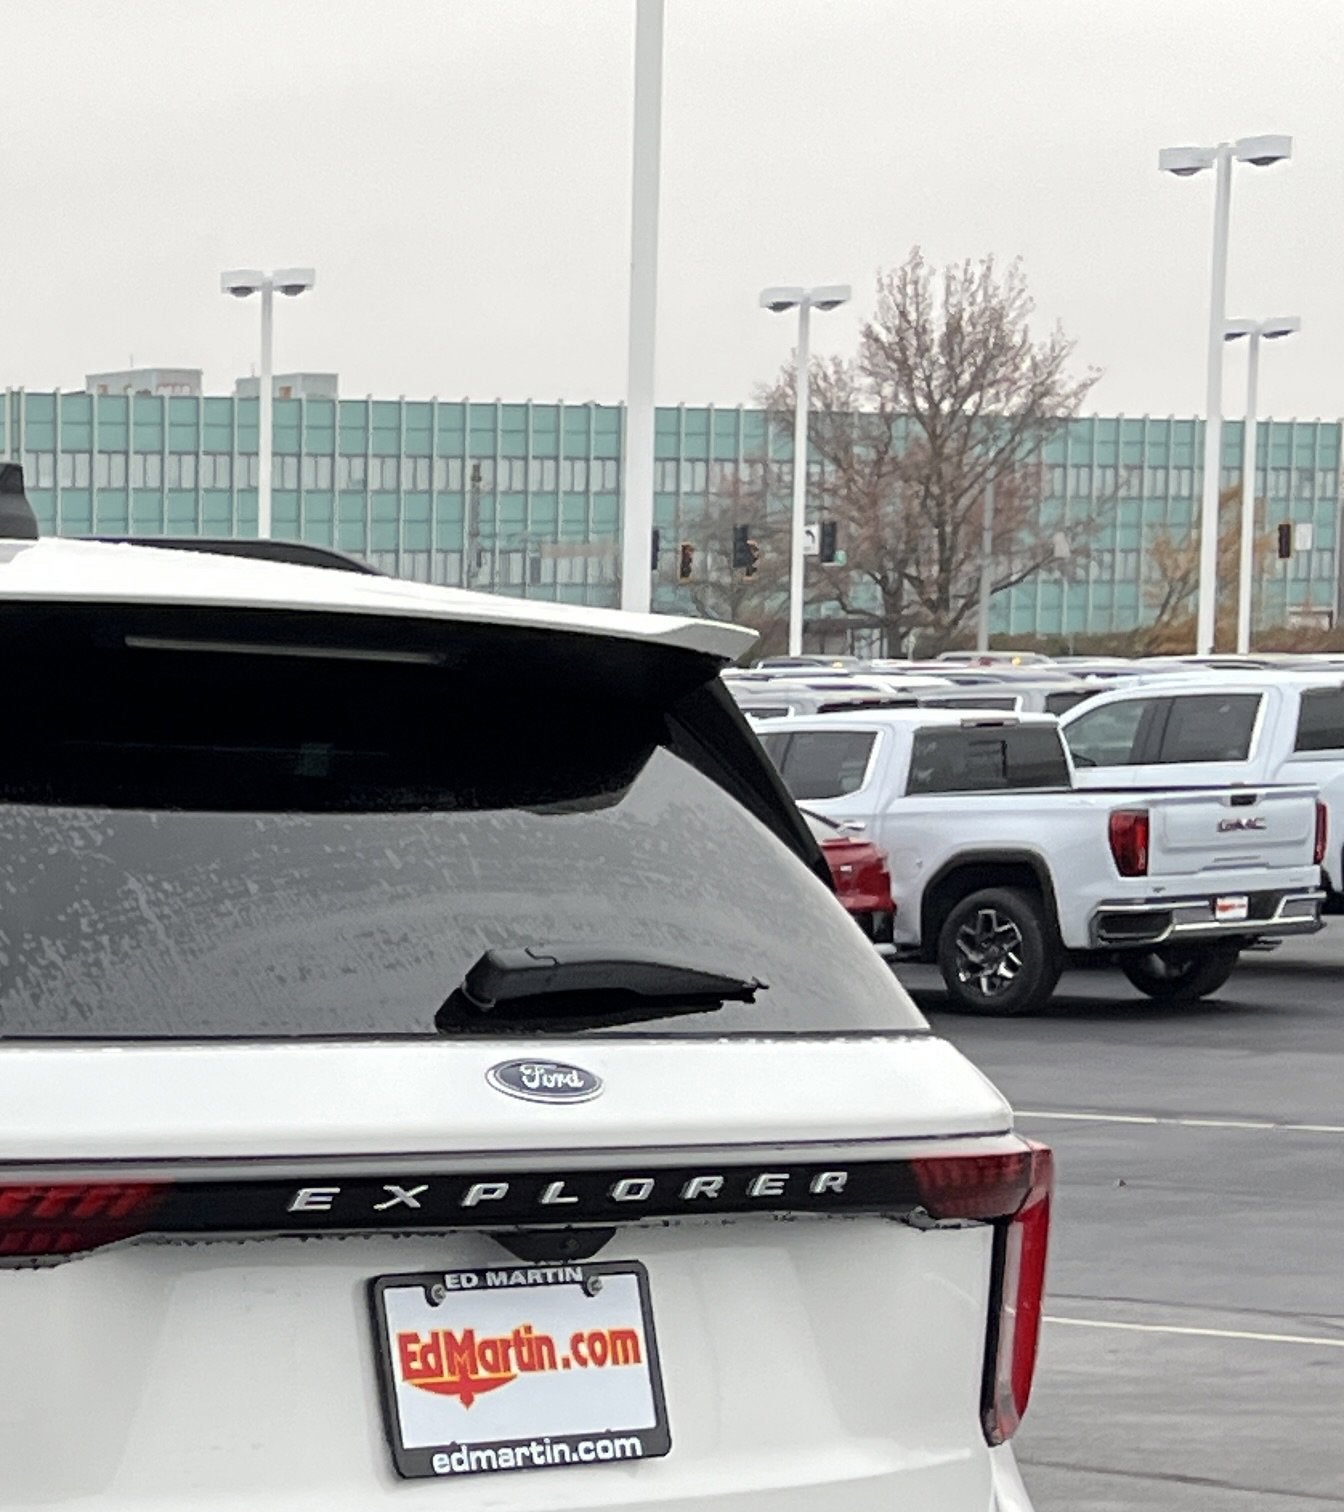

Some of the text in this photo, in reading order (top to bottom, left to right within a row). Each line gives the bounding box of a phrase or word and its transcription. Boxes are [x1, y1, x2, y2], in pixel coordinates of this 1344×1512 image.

[1216, 817, 1267, 833] GMC
[519, 1063, 585, 1089] Ford
[287, 1171, 848, 1212] EXPLORER
[444, 1267, 584, 1289] ED MARTIN
[397, 1323, 642, 1378] EdMartin.com
[432, 1436, 643, 1475] edmartin.com
